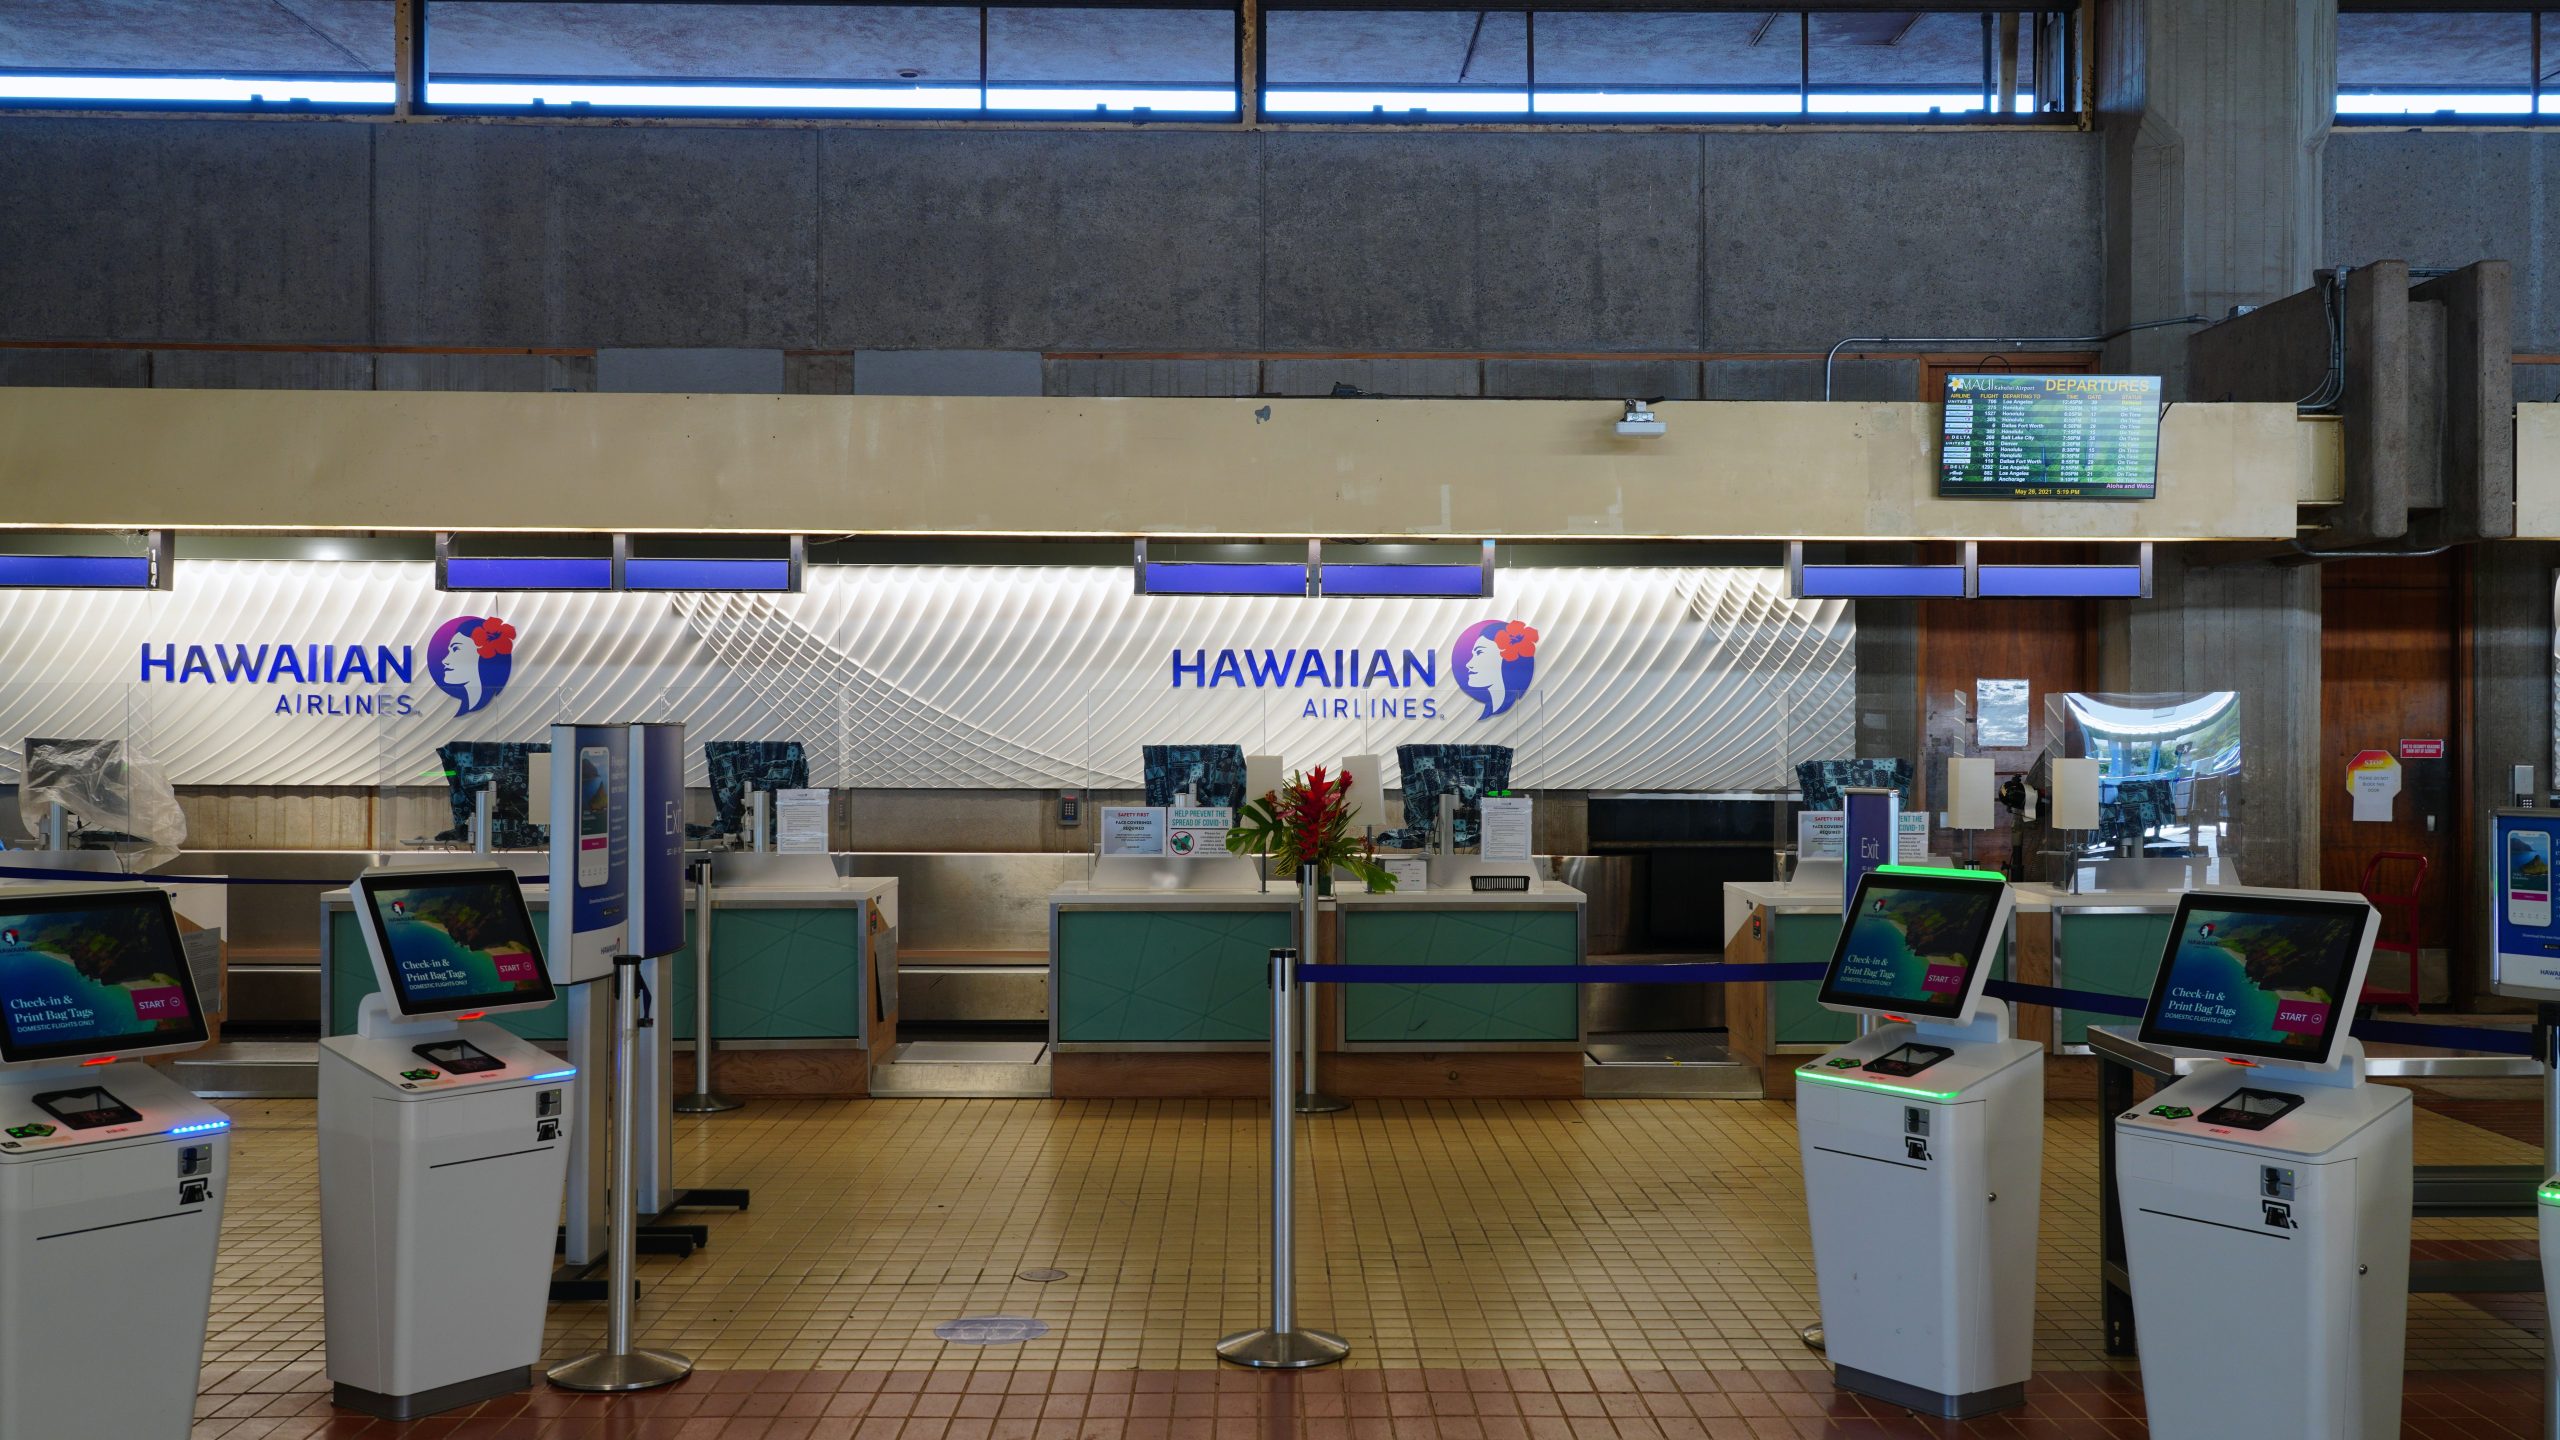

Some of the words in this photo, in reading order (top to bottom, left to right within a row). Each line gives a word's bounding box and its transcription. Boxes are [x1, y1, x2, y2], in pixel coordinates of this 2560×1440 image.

[2046, 379, 2150, 391] DEPARTURES
[140, 643, 412, 683] HAWAIIAN
[1172, 649, 1436, 688] HAWAIIAN
[275, 694, 412, 715] AIRLINES
[1303, 698, 1436, 718] AIRLINES
[666, 800, 682, 835] Exit
[1861, 837, 1879, 859] Exit
[402, 959, 440, 970] Check-in
[1848, 954, 1880, 966] Check-in
[500, 964, 520, 972] START
[1844, 966, 1862, 976] Print
[1864, 967, 1878, 978] Bag
[1879, 969, 1896, 979] Tags
[407, 972, 428, 982] Print
[430, 970, 446, 983] Bag
[447, 970, 466, 980] Tags
[1928, 975, 1949, 984] START
[2172, 987, 2214, 1000] Check-in
[2216, 992, 2225, 1000] &
[10, 995, 62, 1010] Check-in
[64, 995, 73, 1004] &
[139, 1000, 165, 1010] START
[2168, 1000, 2192, 1013] Print
[2195, 1002, 2213, 1016] Bag
[2214, 1005, 2236, 1017] Tags
[14, 1012, 44, 1023] Print
[47, 1009, 67, 1024] Bag
[70, 1008, 94, 1020] Tags
[2165, 1013, 2194, 1021] DOMESTIC
[2194, 1015, 2216, 1023] FLIGHTS
[2280, 1012, 2307, 1022] START
[17, 1024, 51, 1033] DOMESTIC
